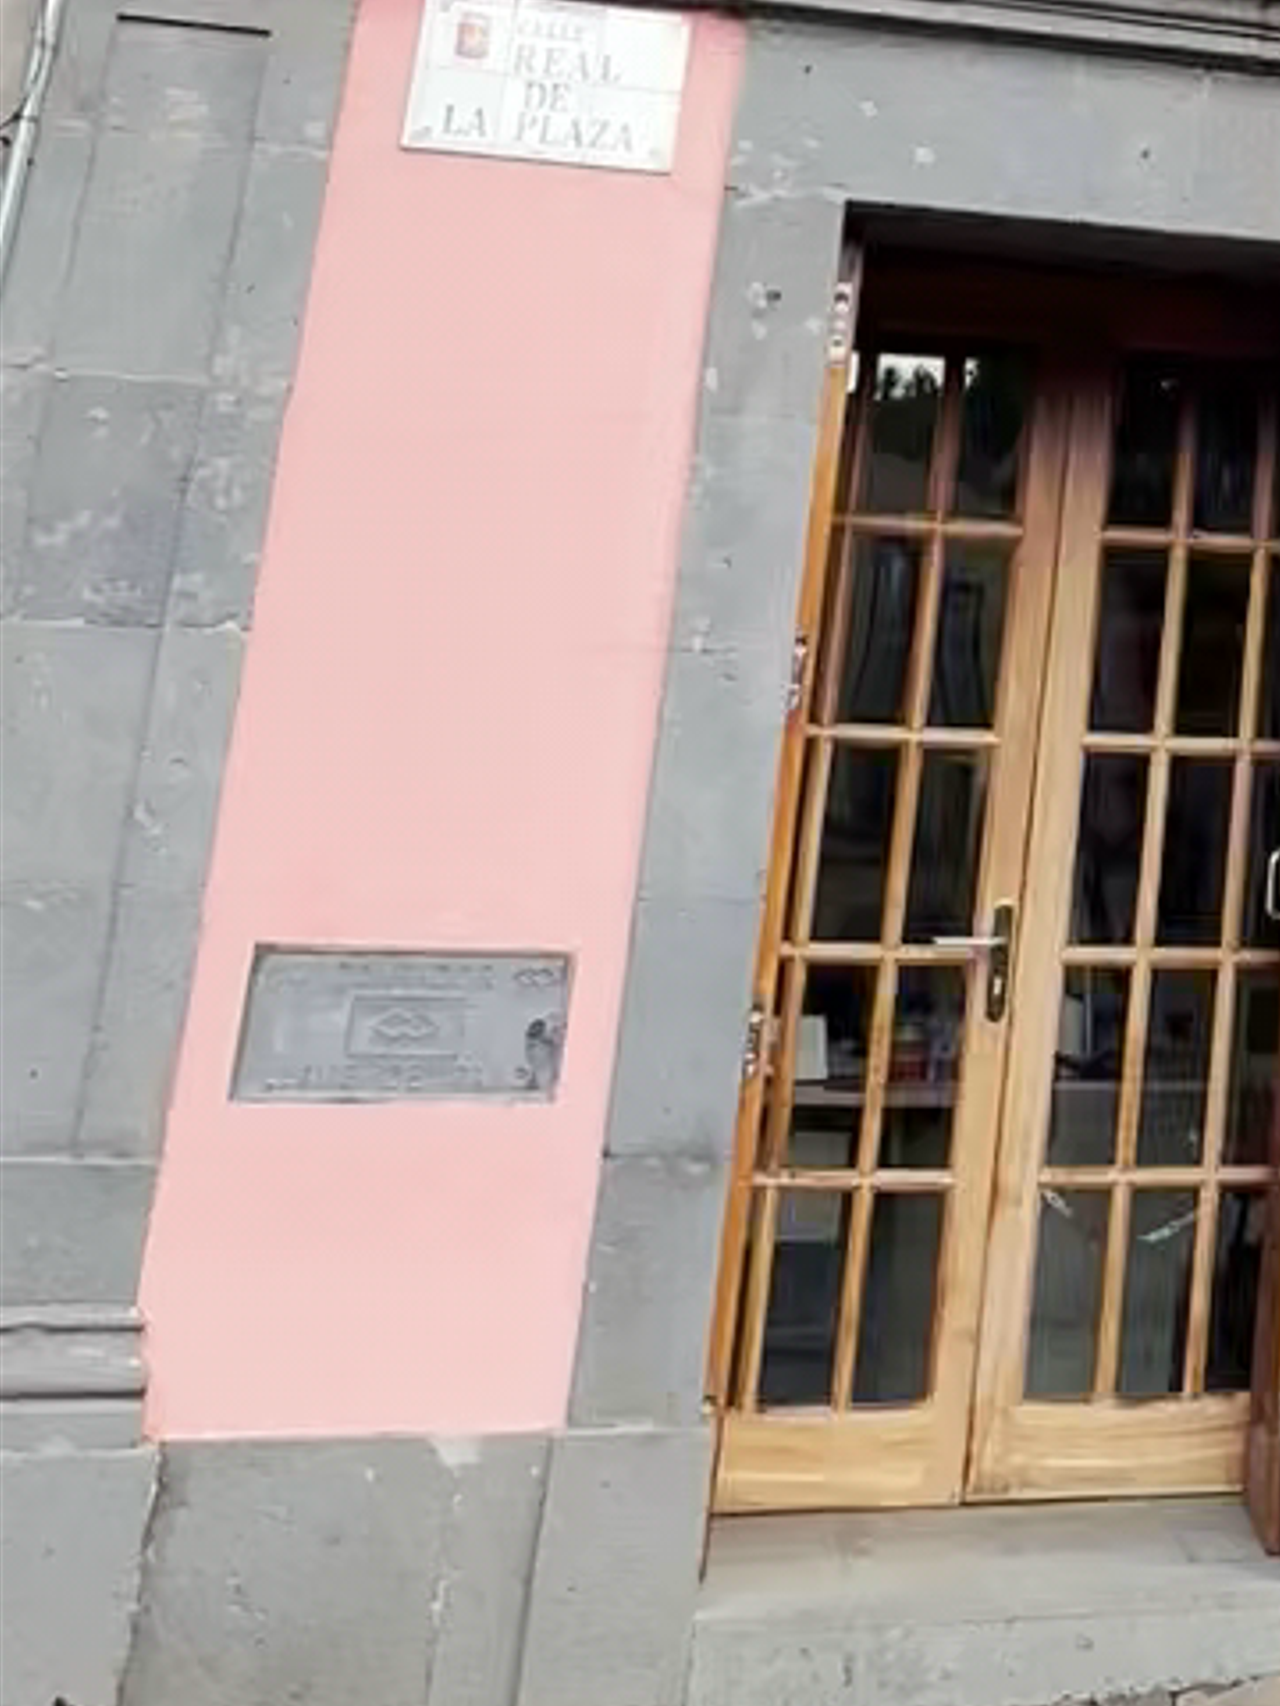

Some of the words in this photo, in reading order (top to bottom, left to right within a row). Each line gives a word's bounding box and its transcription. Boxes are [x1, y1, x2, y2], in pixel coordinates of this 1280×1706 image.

[513, 43, 622, 83] REAL
[523, 80, 572, 113] DE
[442, 103, 487, 137] LA
[513, 111, 633, 152] PLAZA
